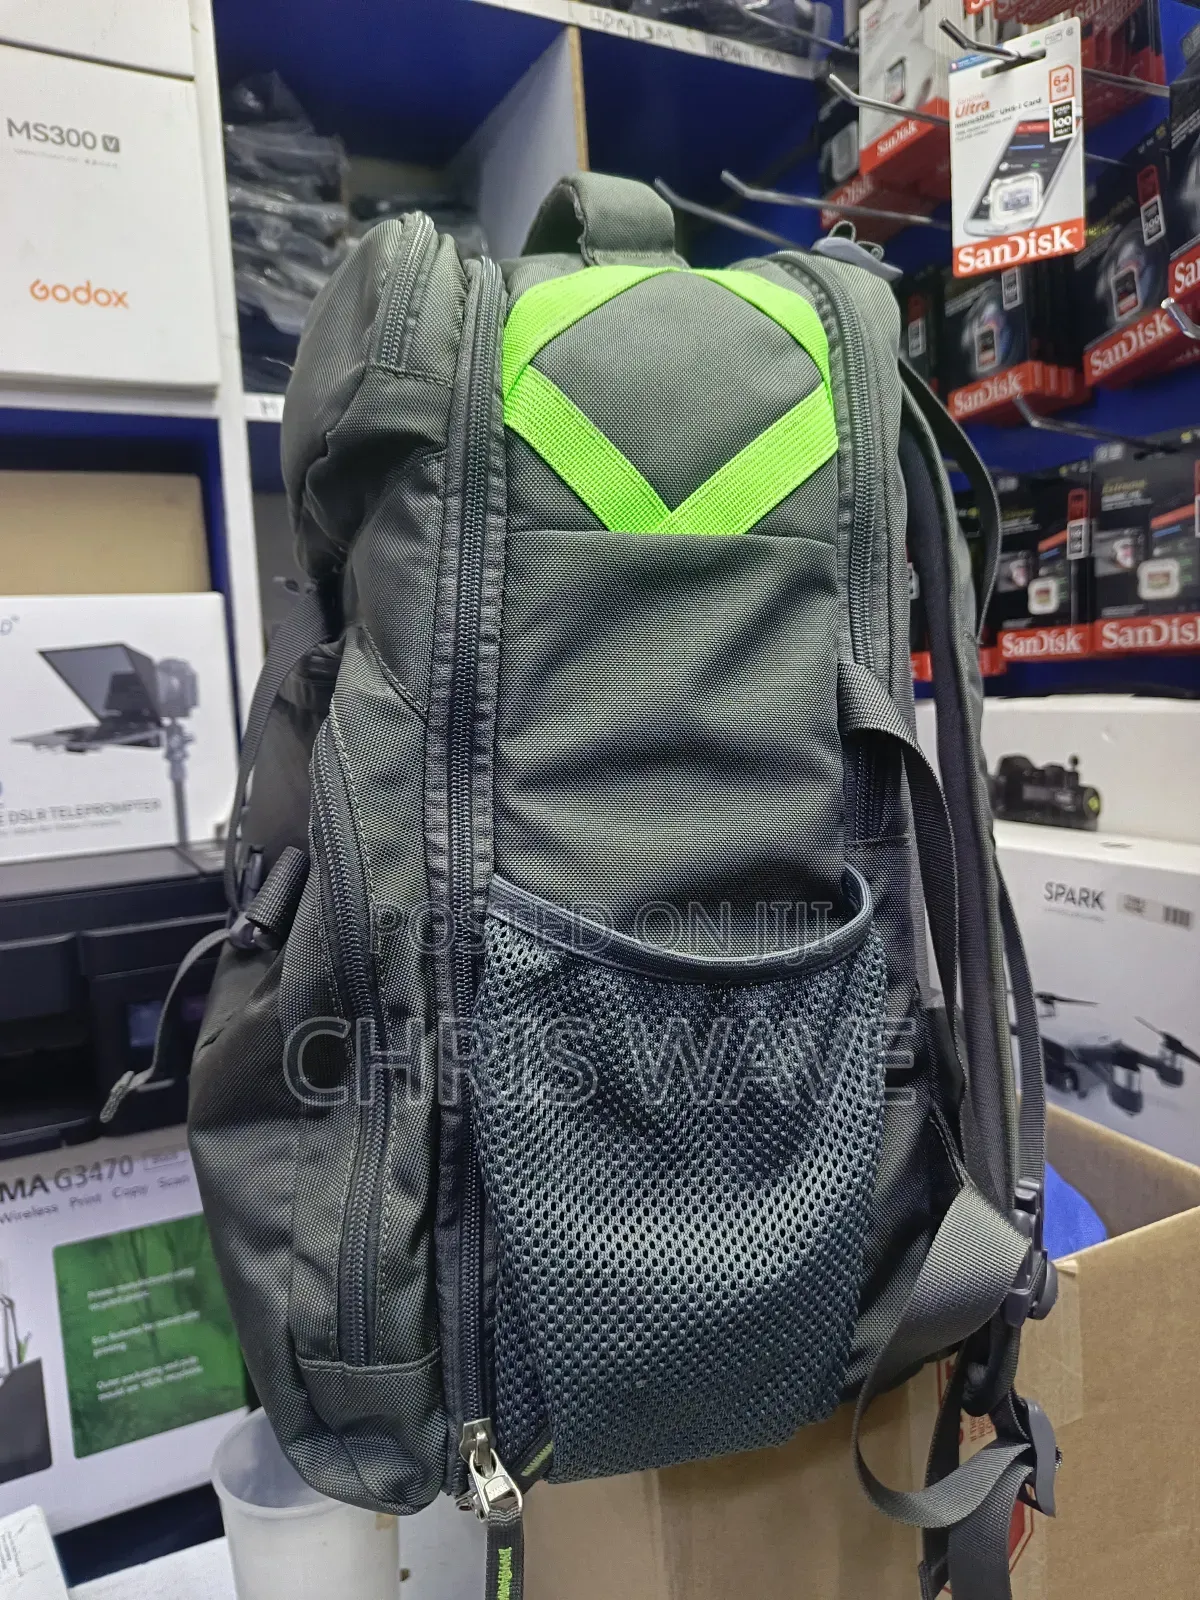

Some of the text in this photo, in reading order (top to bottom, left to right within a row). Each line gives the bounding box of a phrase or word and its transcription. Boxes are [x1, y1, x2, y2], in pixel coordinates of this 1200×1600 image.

[1053, 72, 1070, 87] 64
[955, 100, 990, 118] Ultra
[1054, 115, 1072, 129] 100
[6, 117, 97, 150] MS300
[957, 225, 1079, 273] SanDisk
[29, 278, 129, 309] Godox
[1089, 313, 1173, 376] SanDisk
[953, 370, 1024, 413] SanDisk
[1002, 627, 1083, 657] SanDisk
[1043, 881, 1106, 911] SPARK
[53, 1154, 134, 1192] G3470
